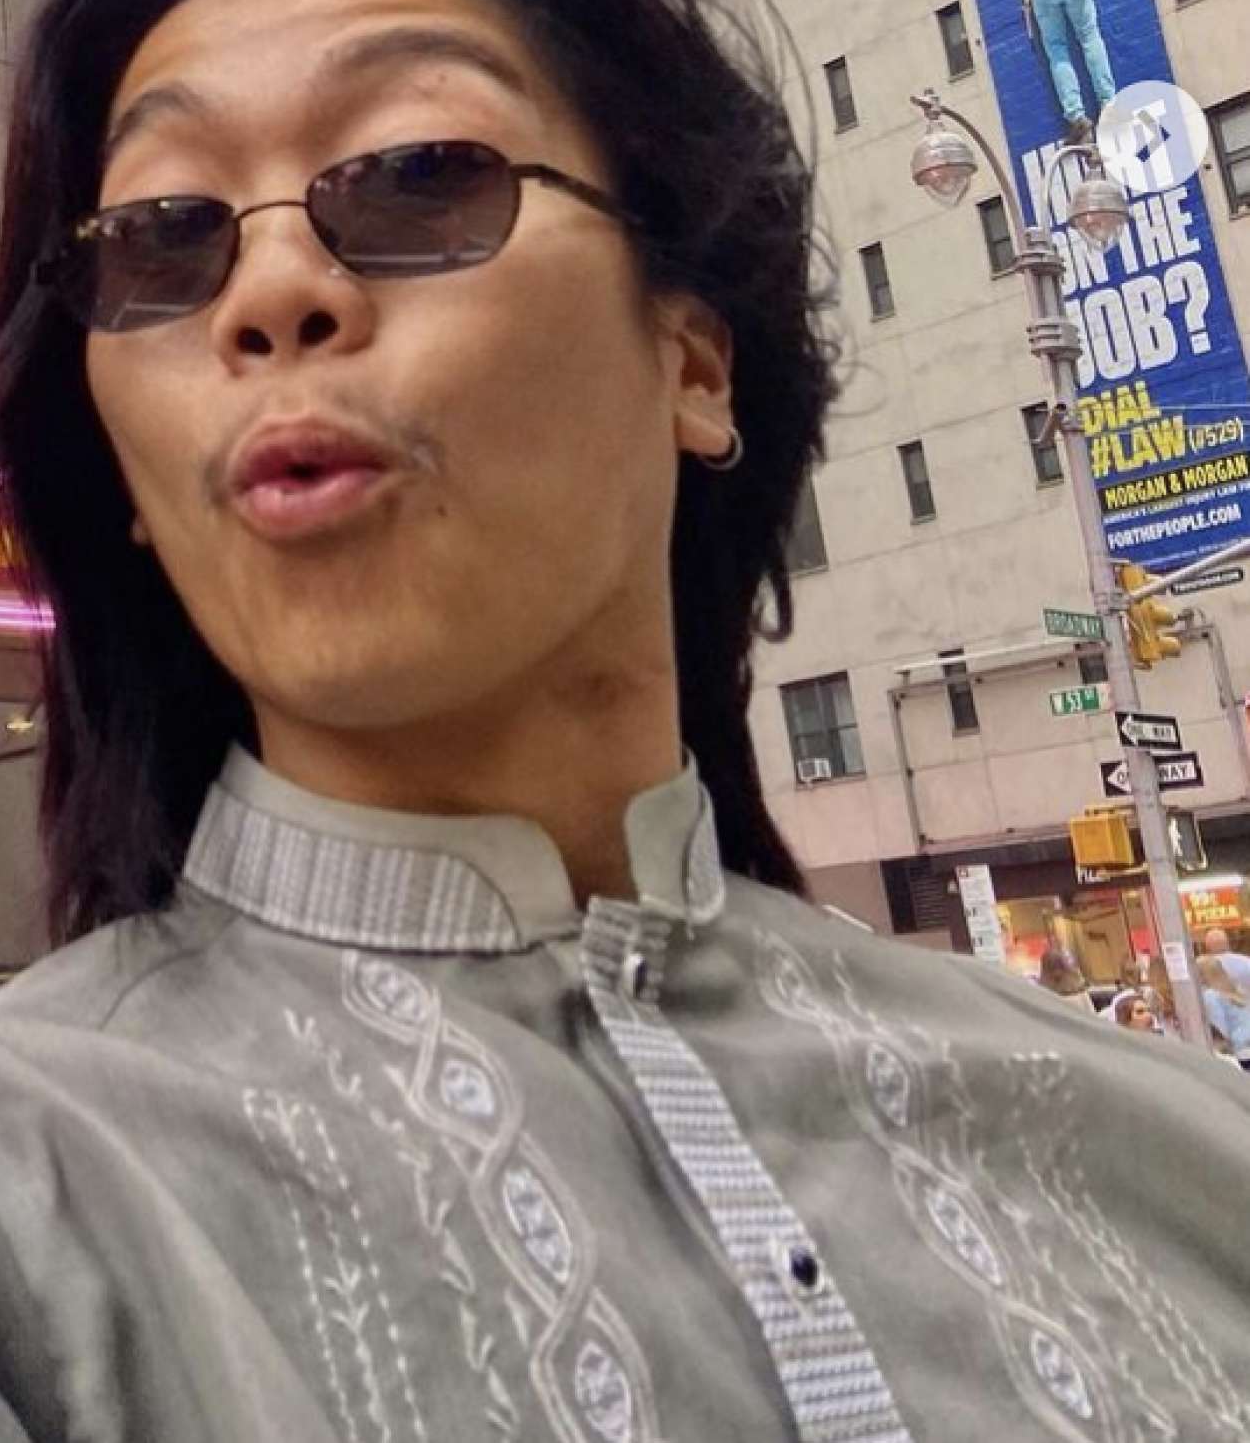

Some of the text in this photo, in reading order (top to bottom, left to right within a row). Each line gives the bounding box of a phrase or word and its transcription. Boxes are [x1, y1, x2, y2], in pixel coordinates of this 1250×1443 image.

[1078, 380, 1160, 437] DIAL
[1091, 415, 1186, 479] #LAW
[1104, 475, 1168, 510] MORGAN
[1170, 473, 1181, 494] &
[1183, 454, 1249, 490] MORGAN
[1107, 503, 1242, 550] FORTHEPEOPLE.COM
